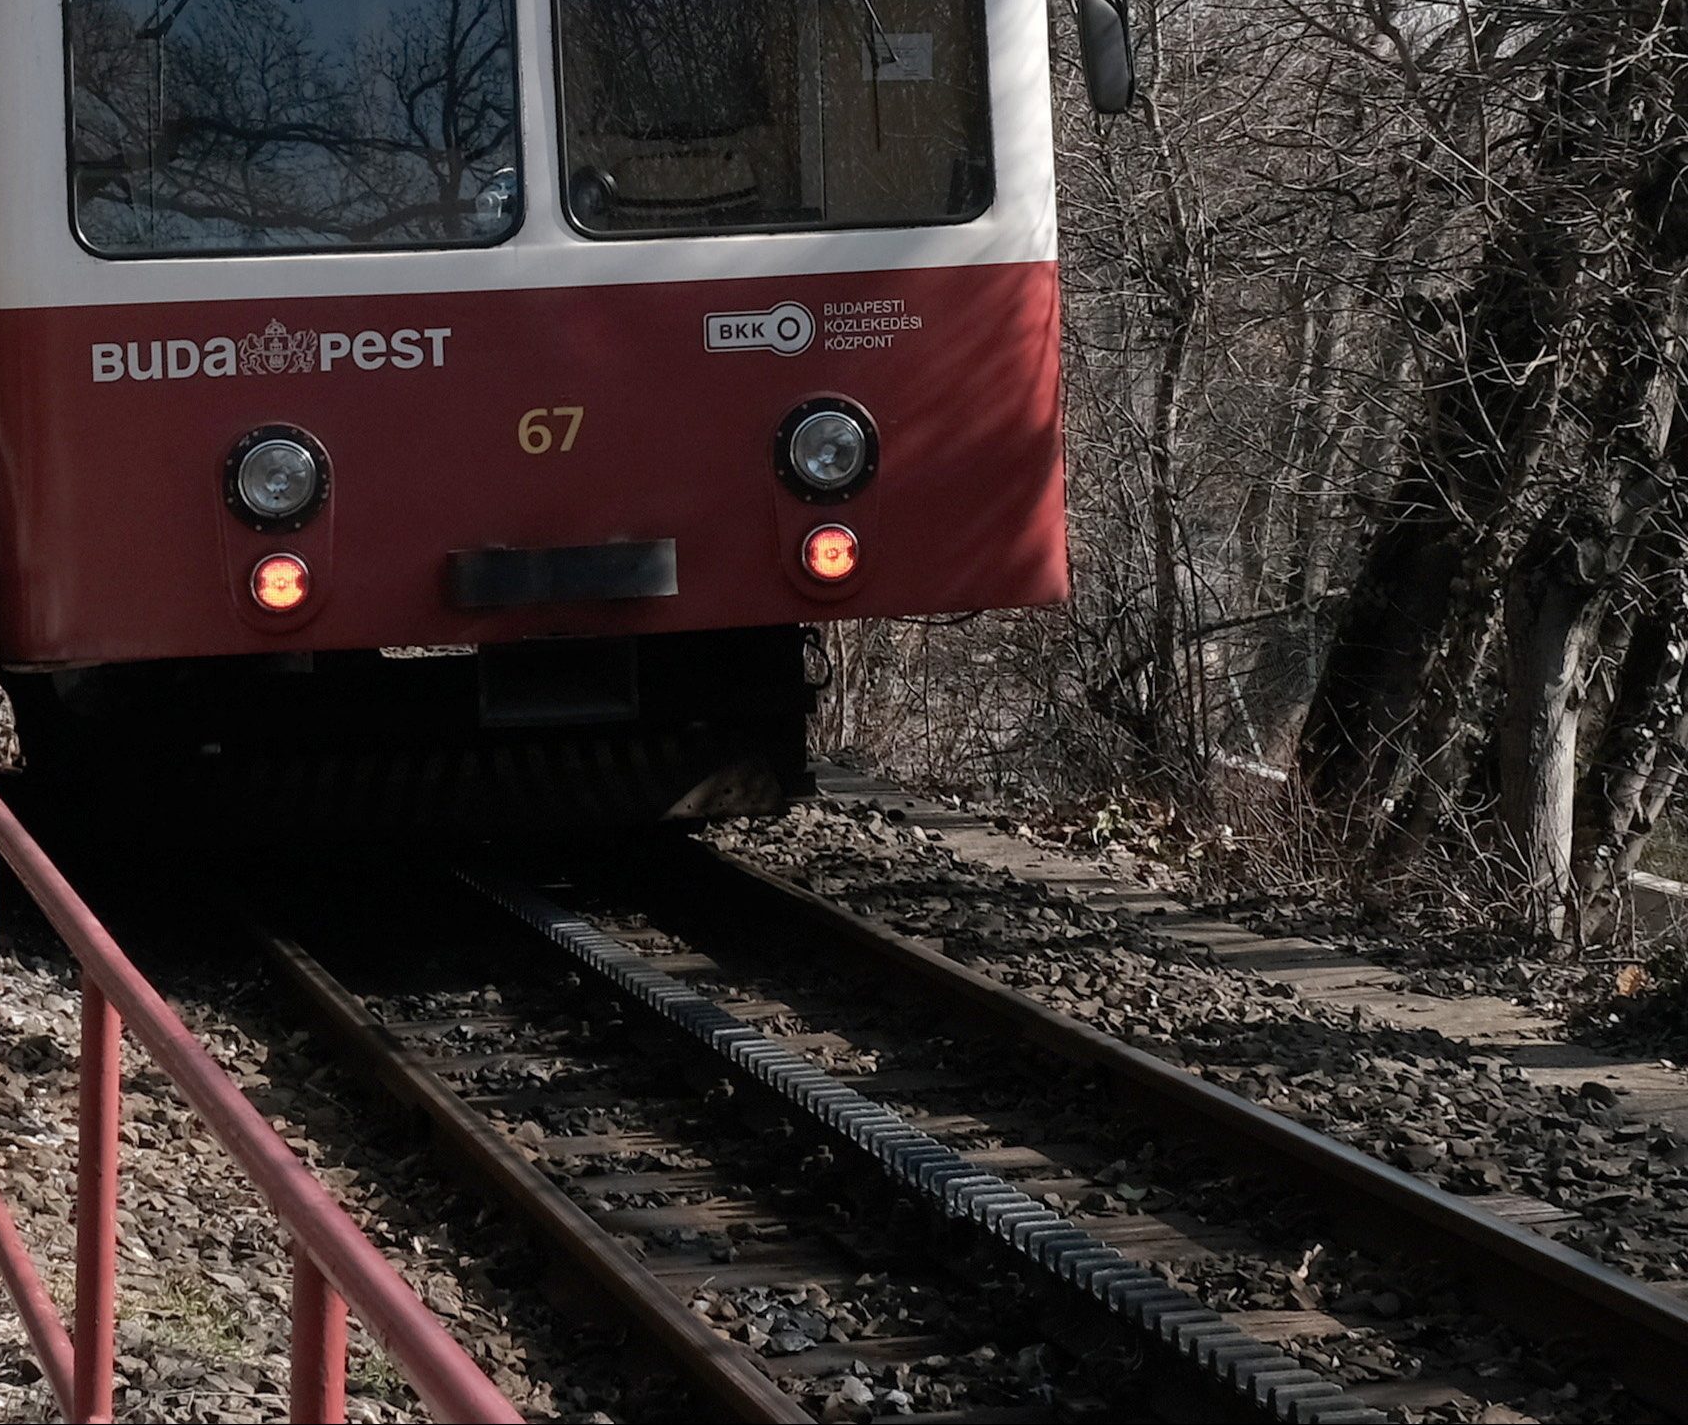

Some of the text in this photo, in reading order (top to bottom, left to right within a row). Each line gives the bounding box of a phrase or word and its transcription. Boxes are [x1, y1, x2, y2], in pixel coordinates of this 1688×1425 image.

[823, 299, 905, 316] BUDAPESTI
[719, 322, 765, 340] BKK
[823, 315, 923, 334] KÖZLEKEDÉSI
[823, 334, 895, 351] KÖZPONT
[517, 406, 584, 455] 67
